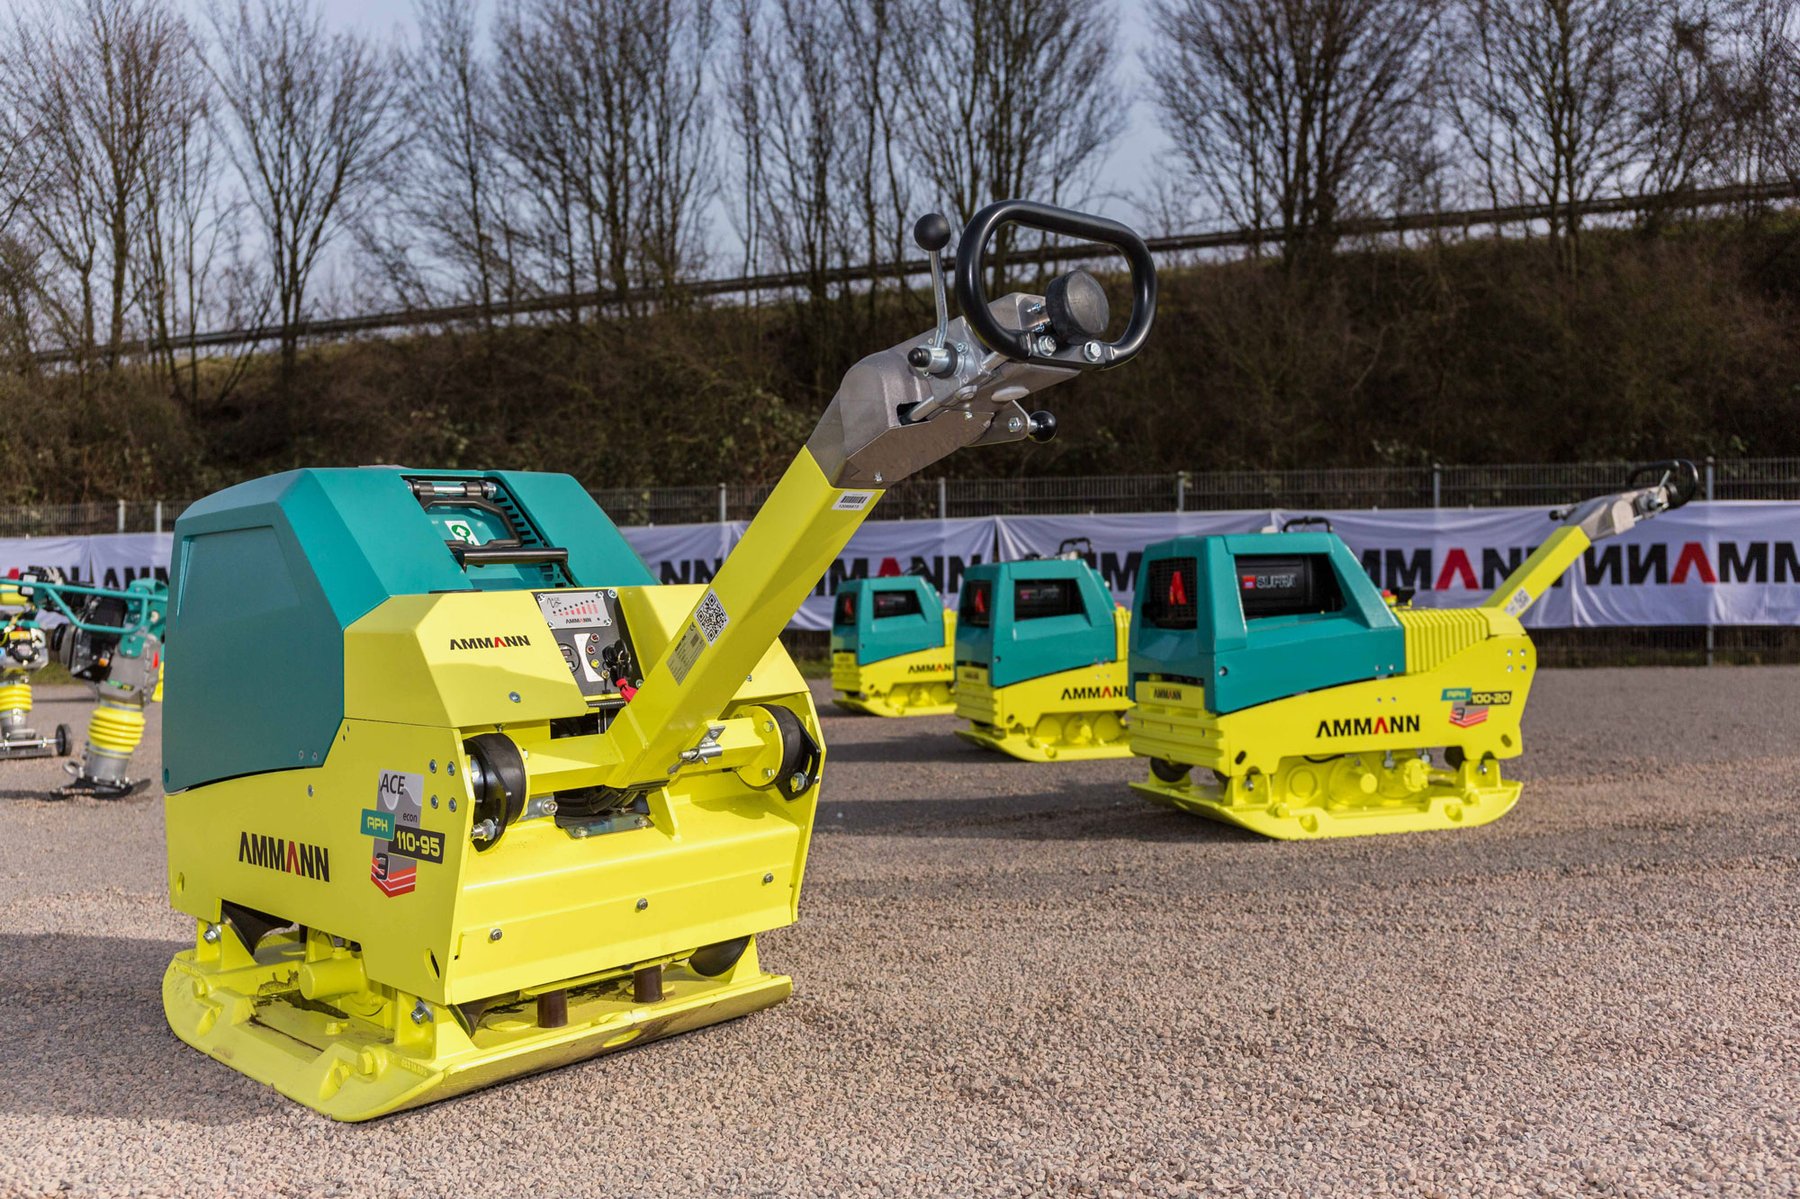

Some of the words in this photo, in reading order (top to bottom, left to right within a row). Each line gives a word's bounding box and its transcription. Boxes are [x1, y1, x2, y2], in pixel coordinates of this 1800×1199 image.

[1257, 574, 1297, 588] SUPRA
[565, 617, 592, 625] AMMANN
[449, 635, 531, 651] AMMANN
[907, 663, 953, 675] AMMAN
[1153, 687, 1182, 702] AMMANN
[1472, 692, 1511, 705] 100-20
[1316, 715, 1420, 739] AMMANN
[379, 773, 406, 795] ACE
[402, 811, 419, 824] econ
[366, 815, 389, 833] APH
[395, 830, 441, 858] 110-95
[238, 831, 330, 883] AMMANN
[373, 852, 389, 881] 3
